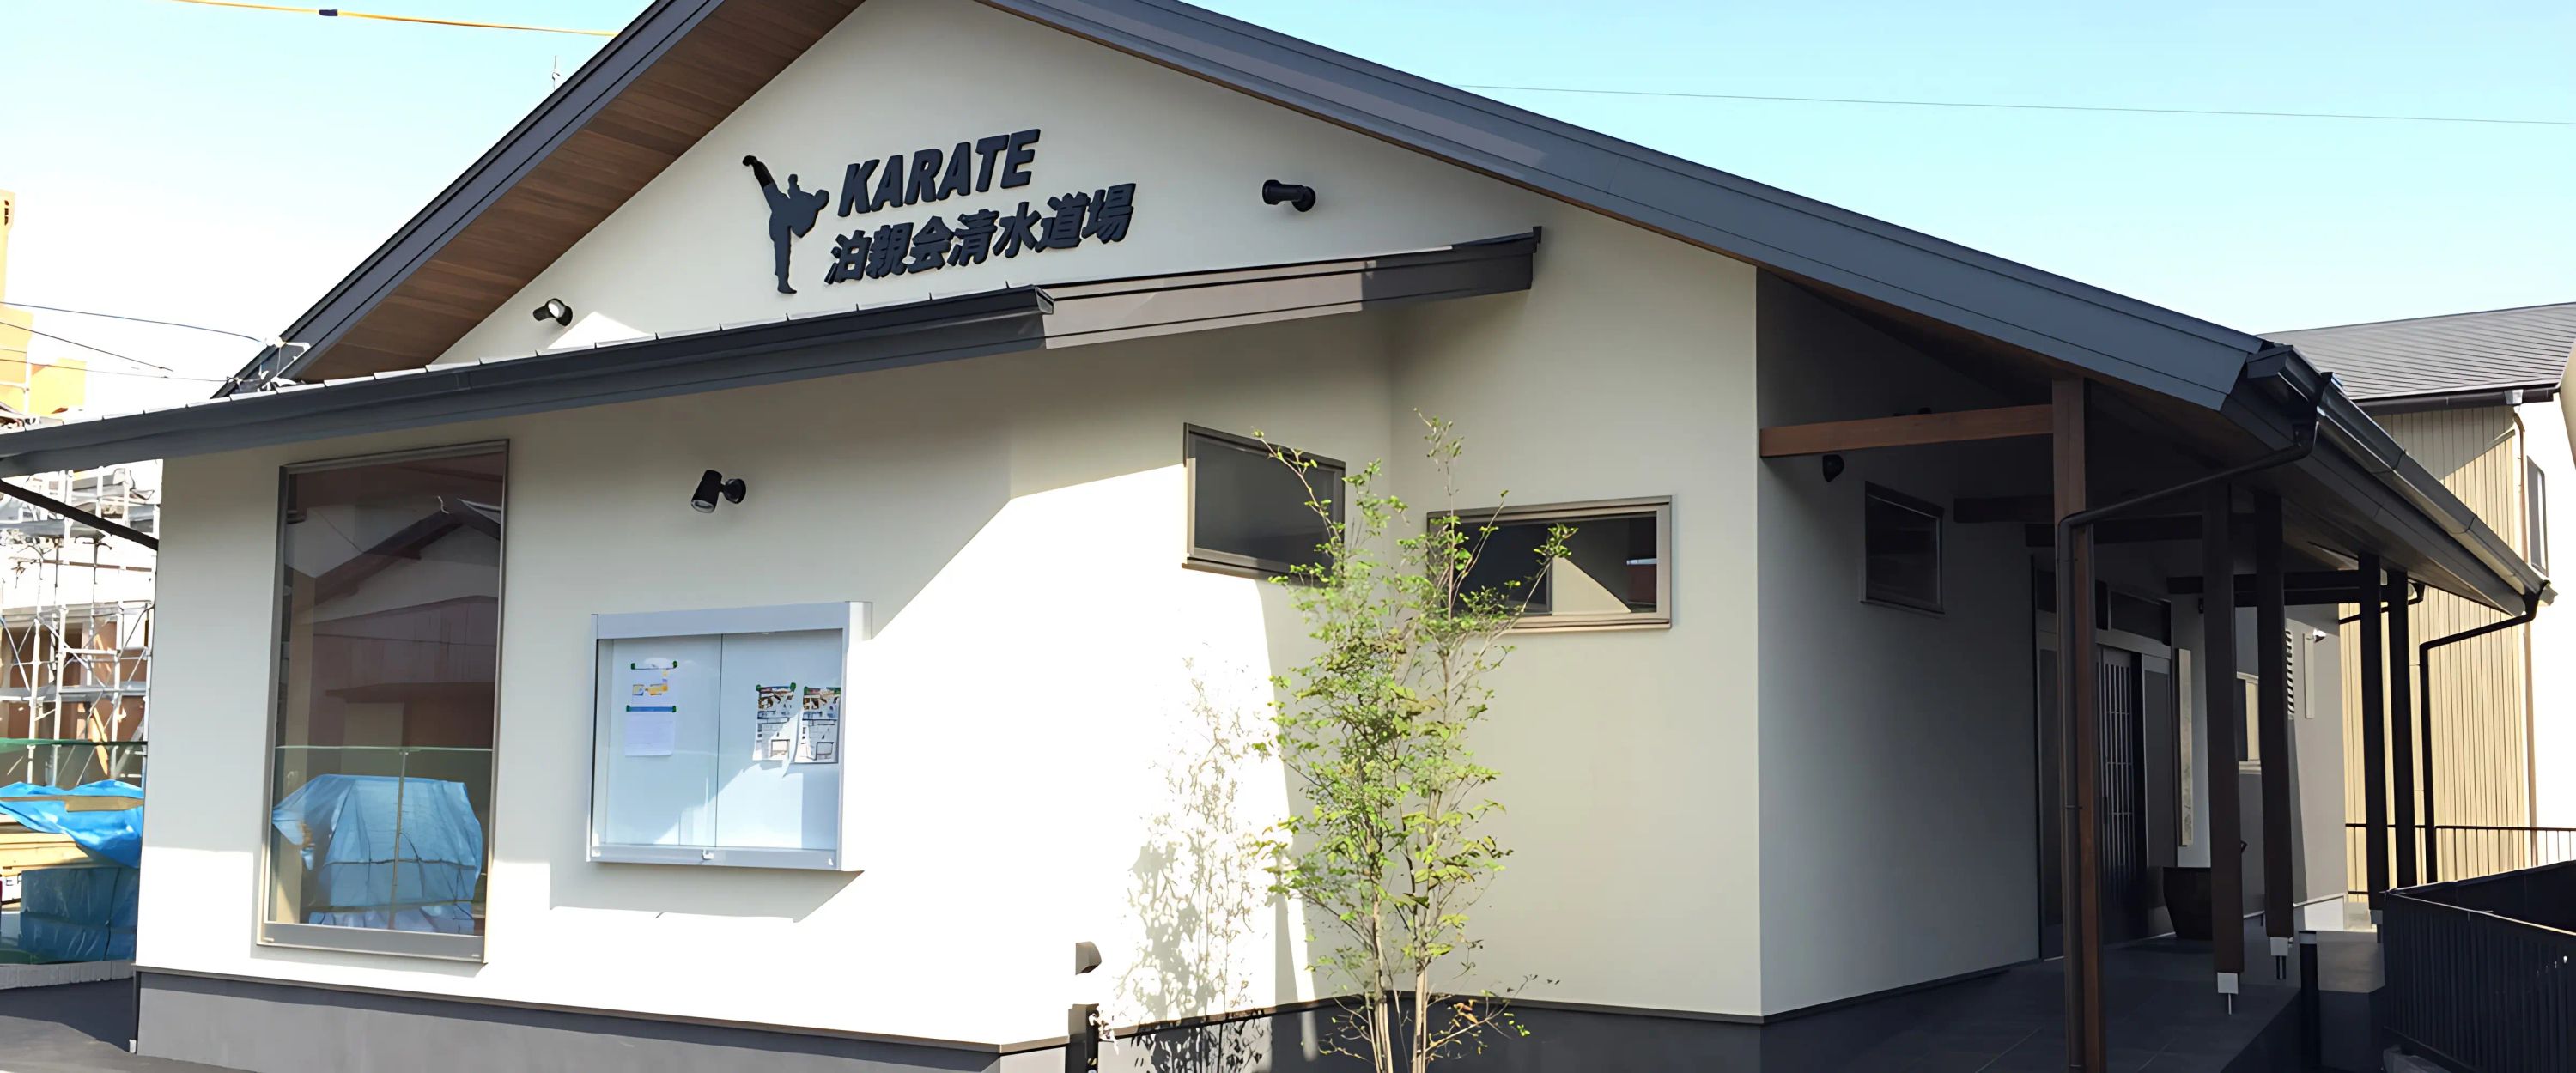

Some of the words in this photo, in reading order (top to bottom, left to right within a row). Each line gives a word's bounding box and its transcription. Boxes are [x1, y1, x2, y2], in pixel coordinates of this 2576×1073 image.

[838, 129, 1041, 217] KARATE
[824, 183, 1136, 285] 泊親会清水道場
